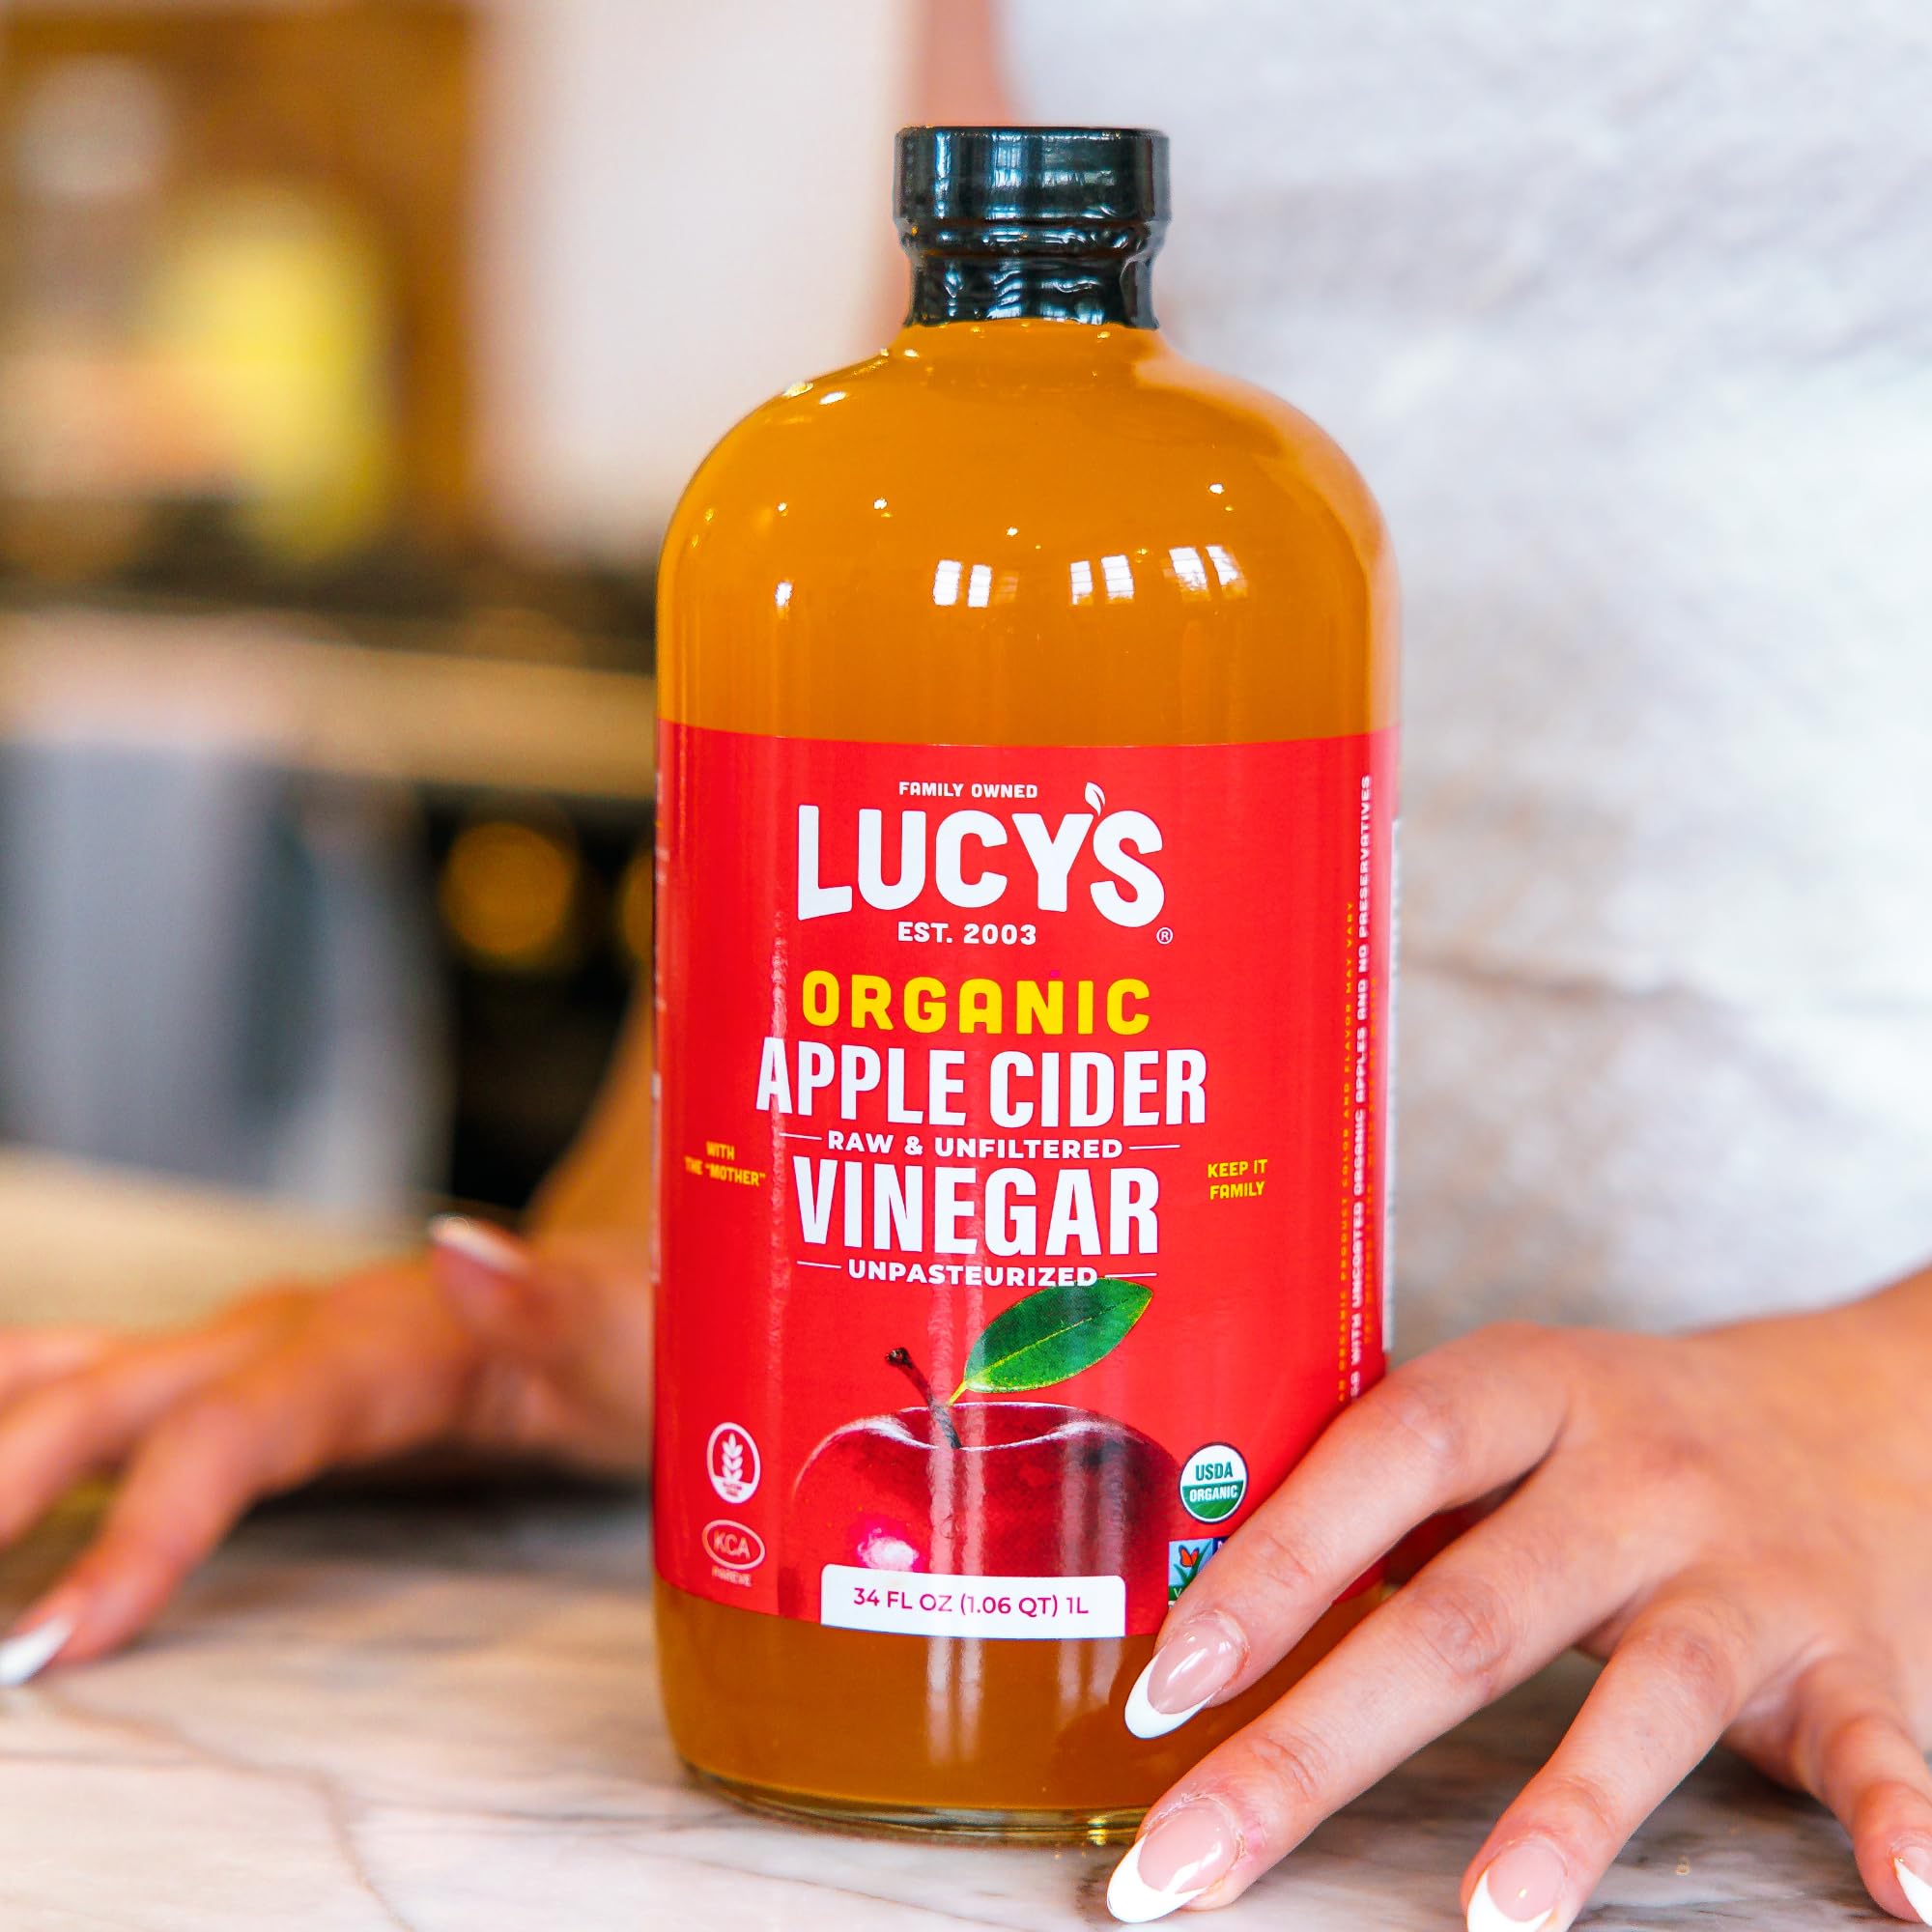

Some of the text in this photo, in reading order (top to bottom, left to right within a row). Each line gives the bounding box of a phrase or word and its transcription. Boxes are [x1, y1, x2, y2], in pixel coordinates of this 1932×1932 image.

[898, 781, 1037, 799] FAMILY OWNED
[1359, 775, 1371, 939] PRESERVATIVES
[898, 921, 1037, 946] EST. 2003
[1358, 944, 1369, 974] NO
[802, 970, 1150, 1035] ORGANIC
[1357, 979, 1368, 1021] AND
[1355, 1026, 1368, 1104] APPLES
[755, 1037, 1208, 1127] APPLE CIDER
[705, 1141, 735, 1160] WITH
[828, 1129, 1123, 1159] RAW & UNFILTERED
[1353, 1108, 1366, 1197] ORGANIC
[685, 1155, 703, 1176] THE
[1208, 1159, 1267, 1179] KEEP IT
[1209, 1181, 1265, 1200] FAMILY
[792, 1156, 1159, 1257] VINEGAR
[848, 1259, 1098, 1287] UNPASTEURIZED
[1195, 1461, 1233, 1482] USDA
[1189, 1485, 1237, 1502] ORGANIC
[853, 1587, 1089, 1617] 34 FL OZ (1.06 QT) 1L
